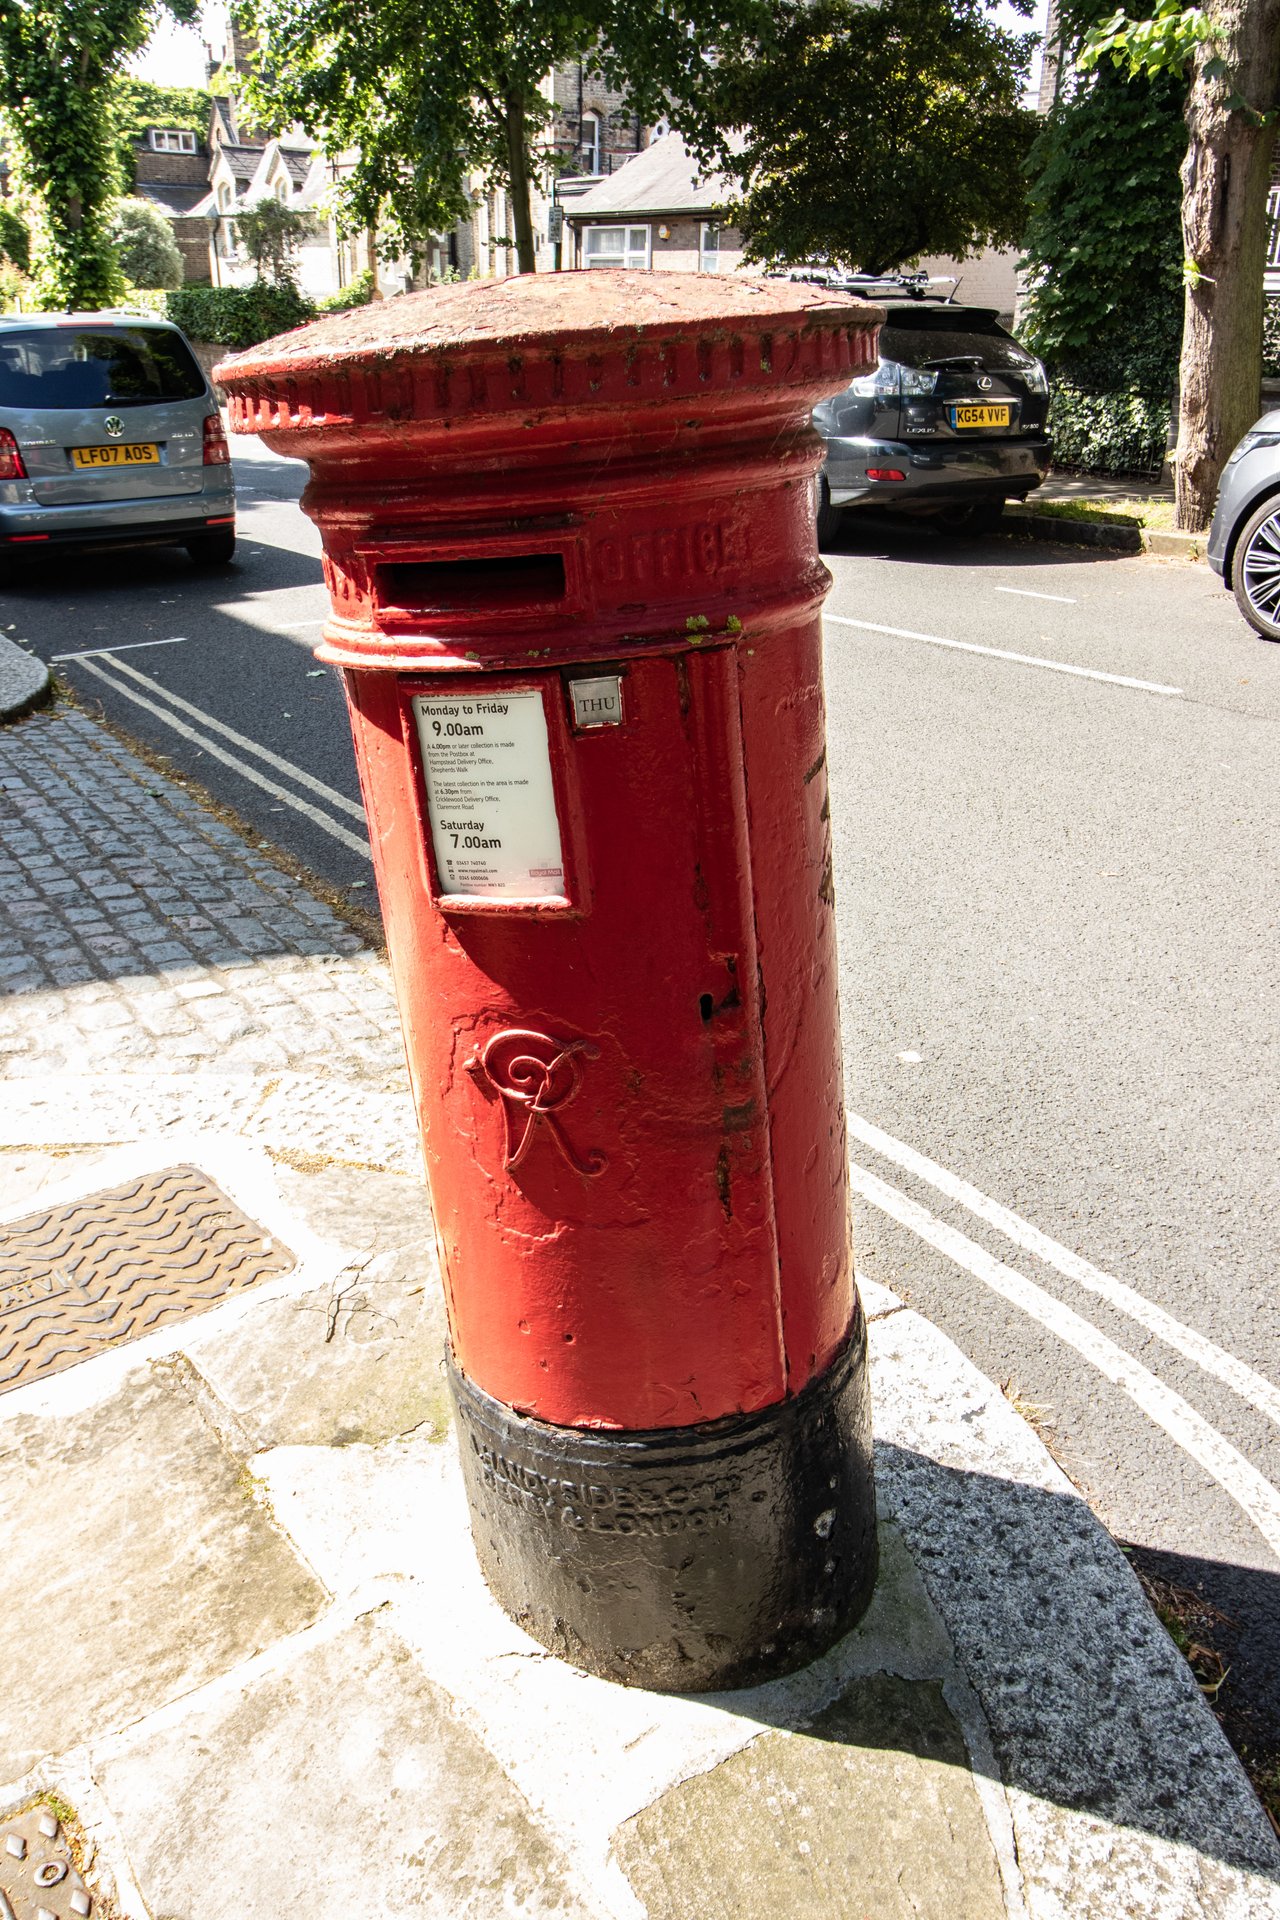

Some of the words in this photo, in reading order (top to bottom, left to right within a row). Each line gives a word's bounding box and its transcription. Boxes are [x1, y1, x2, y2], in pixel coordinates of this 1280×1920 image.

[957, 408, 985, 424] KG54
[987, 407, 1007, 422] VVF
[79, 447, 119, 465] LF07
[421, 705, 460, 717] Monday
[462, 704, 474, 715] to
[476, 703, 509, 715] Friday
[579, 696, 615, 713] THU
[432, 720, 484, 737] 9.00am
[431, 743, 451, 751] 4.00pm
[457, 758, 477, 766] Delivery
[430, 766, 456, 774] Shepherds
[440, 788, 460, 796] 6.30pm
[440, 819, 485, 832] Saturday
[450, 833, 502, 849] 7.00am
[547, 868, 561, 876] Mail
